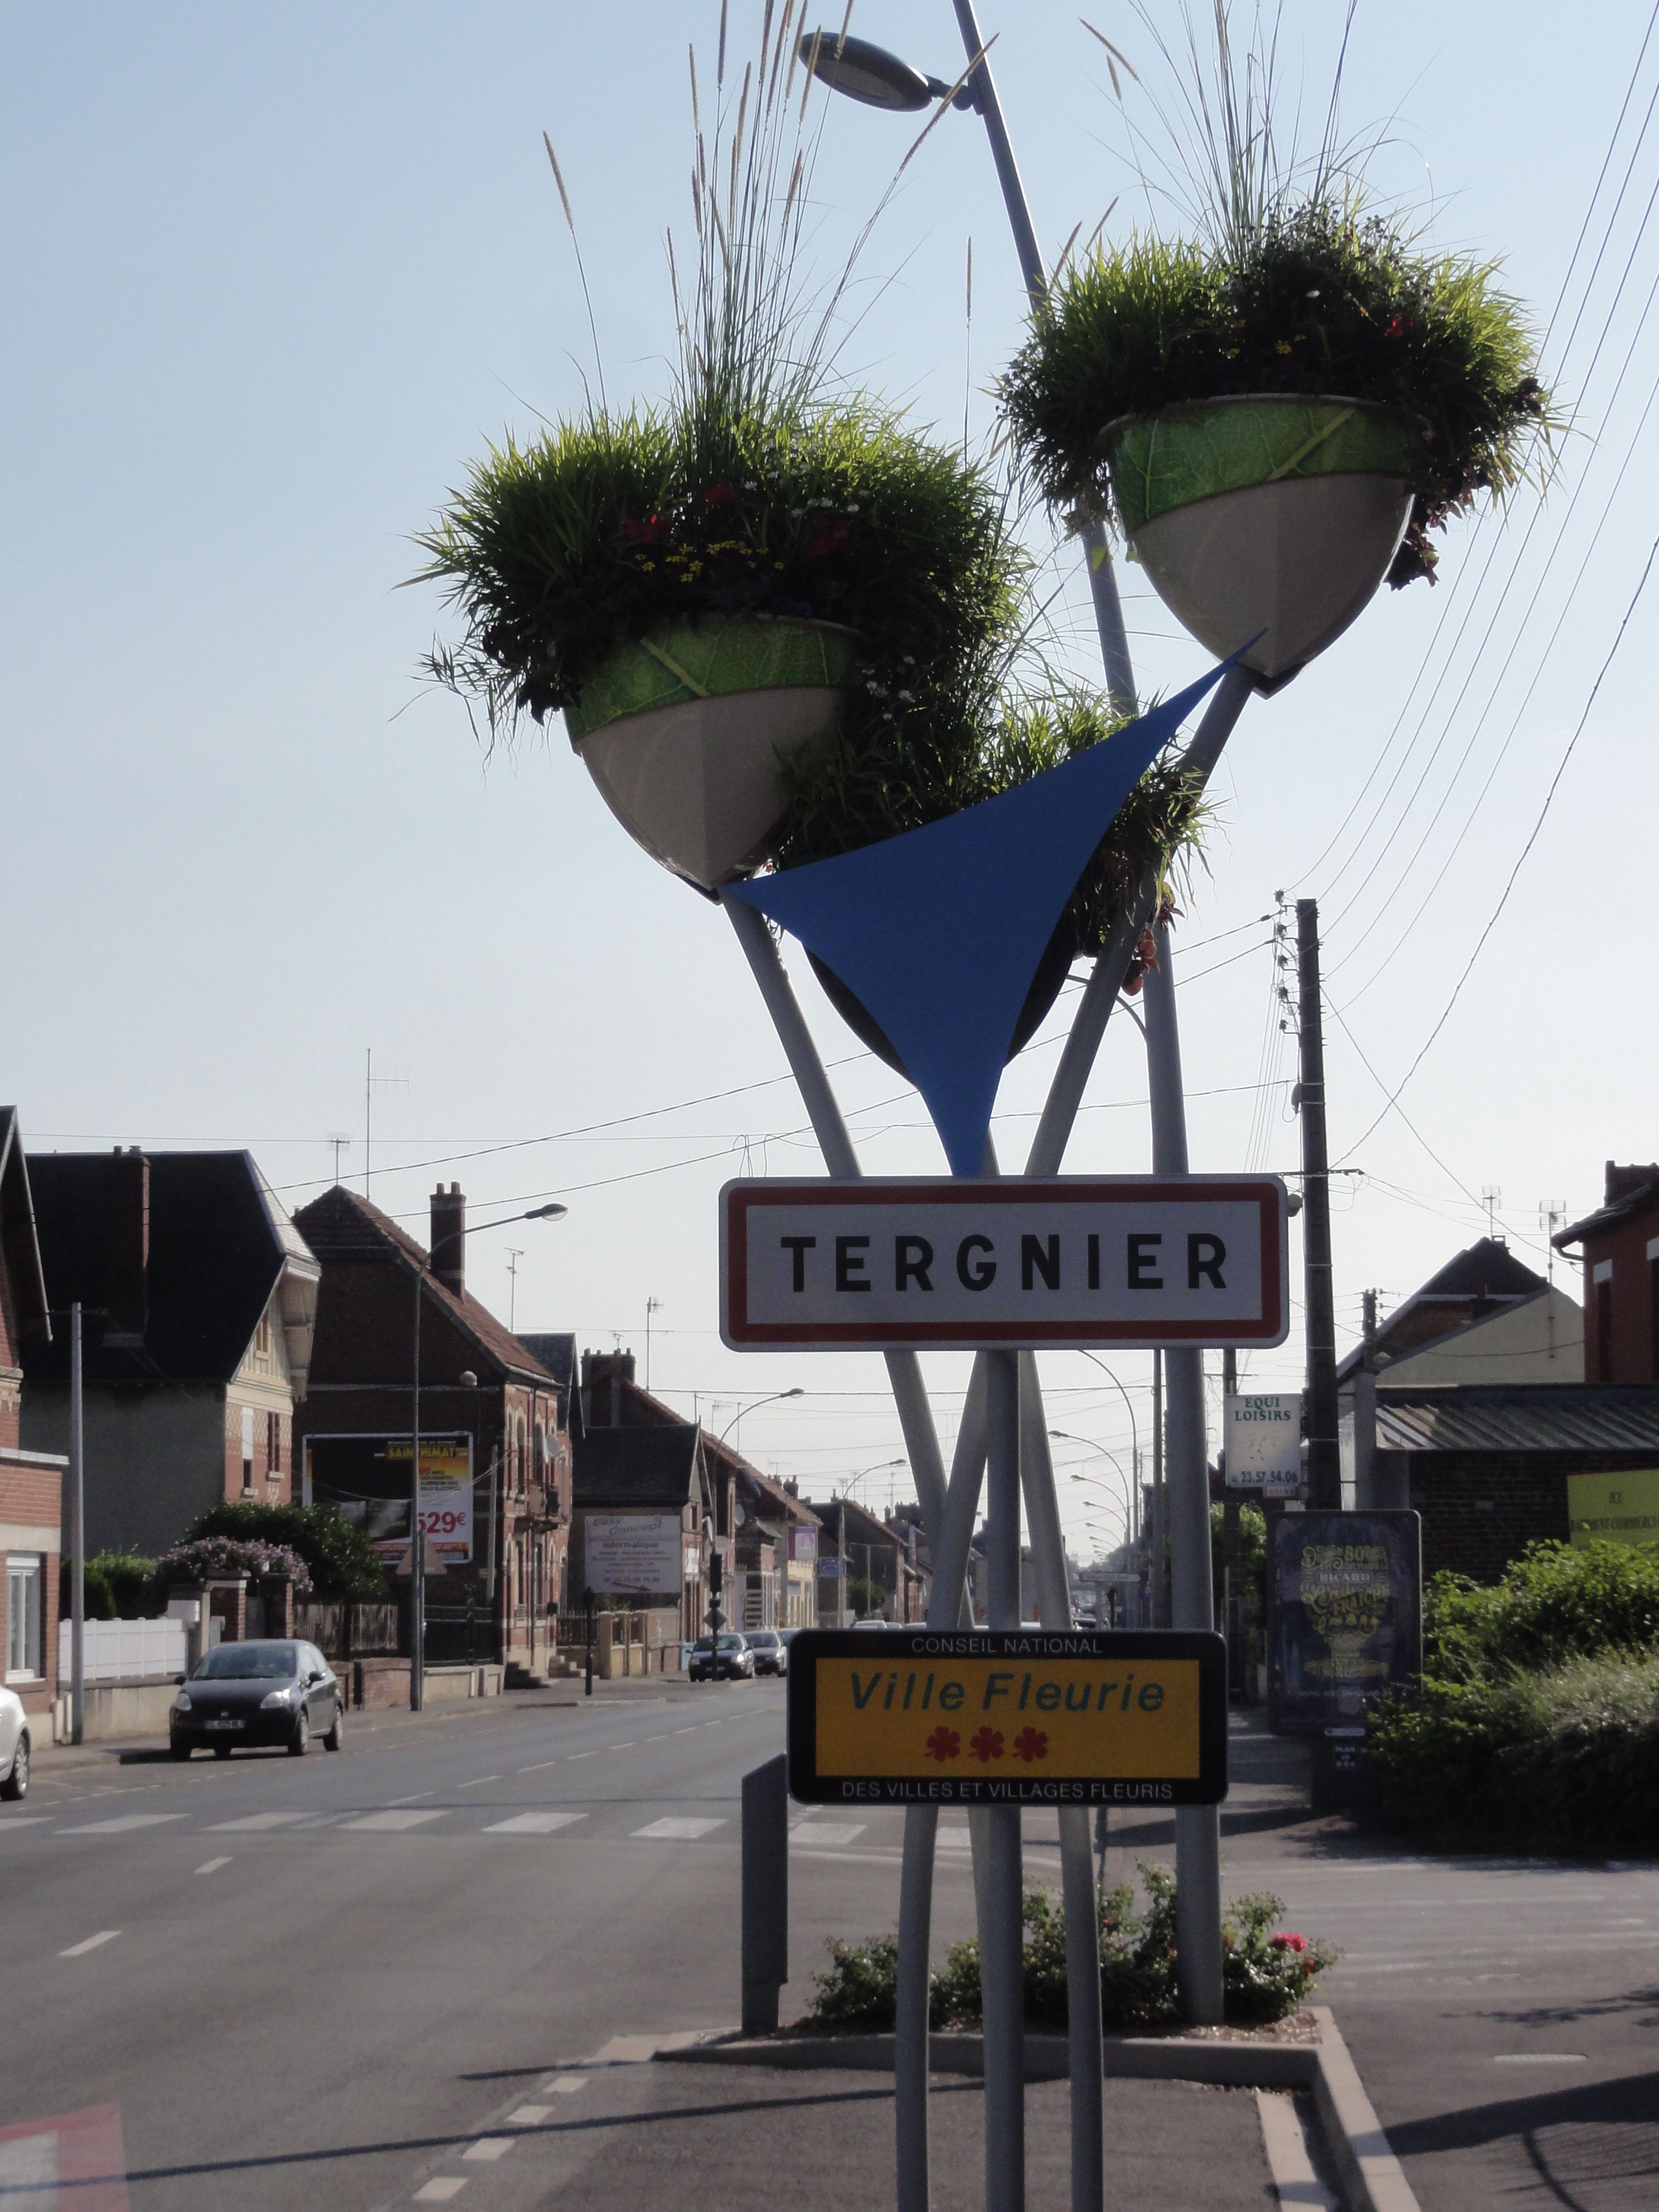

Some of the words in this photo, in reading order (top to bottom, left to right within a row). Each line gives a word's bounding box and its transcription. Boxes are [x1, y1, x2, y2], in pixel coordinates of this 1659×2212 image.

[780, 1233, 1226, 1292] TERGNIER
[1245, 1396, 1280, 1410] EQUI
[1235, 1410, 1291, 1421] LOISIRS
[1319, 1572, 1371, 1582] RICARD
[911, 1638, 997, 1654] CONSEIL
[1005, 1638, 1103, 1654] NATIONAL
[851, 1671, 965, 1710] Ville
[982, 1672, 1165, 1712] Fleurie
[842, 1781, 880, 1798] DES
[888, 1781, 953, 1798] VILLES
[960, 1782, 984, 1798] ET
[989, 1783, 1084, 1798] VILLAGES
[1091, 1784, 1173, 1799] FLEURIS
